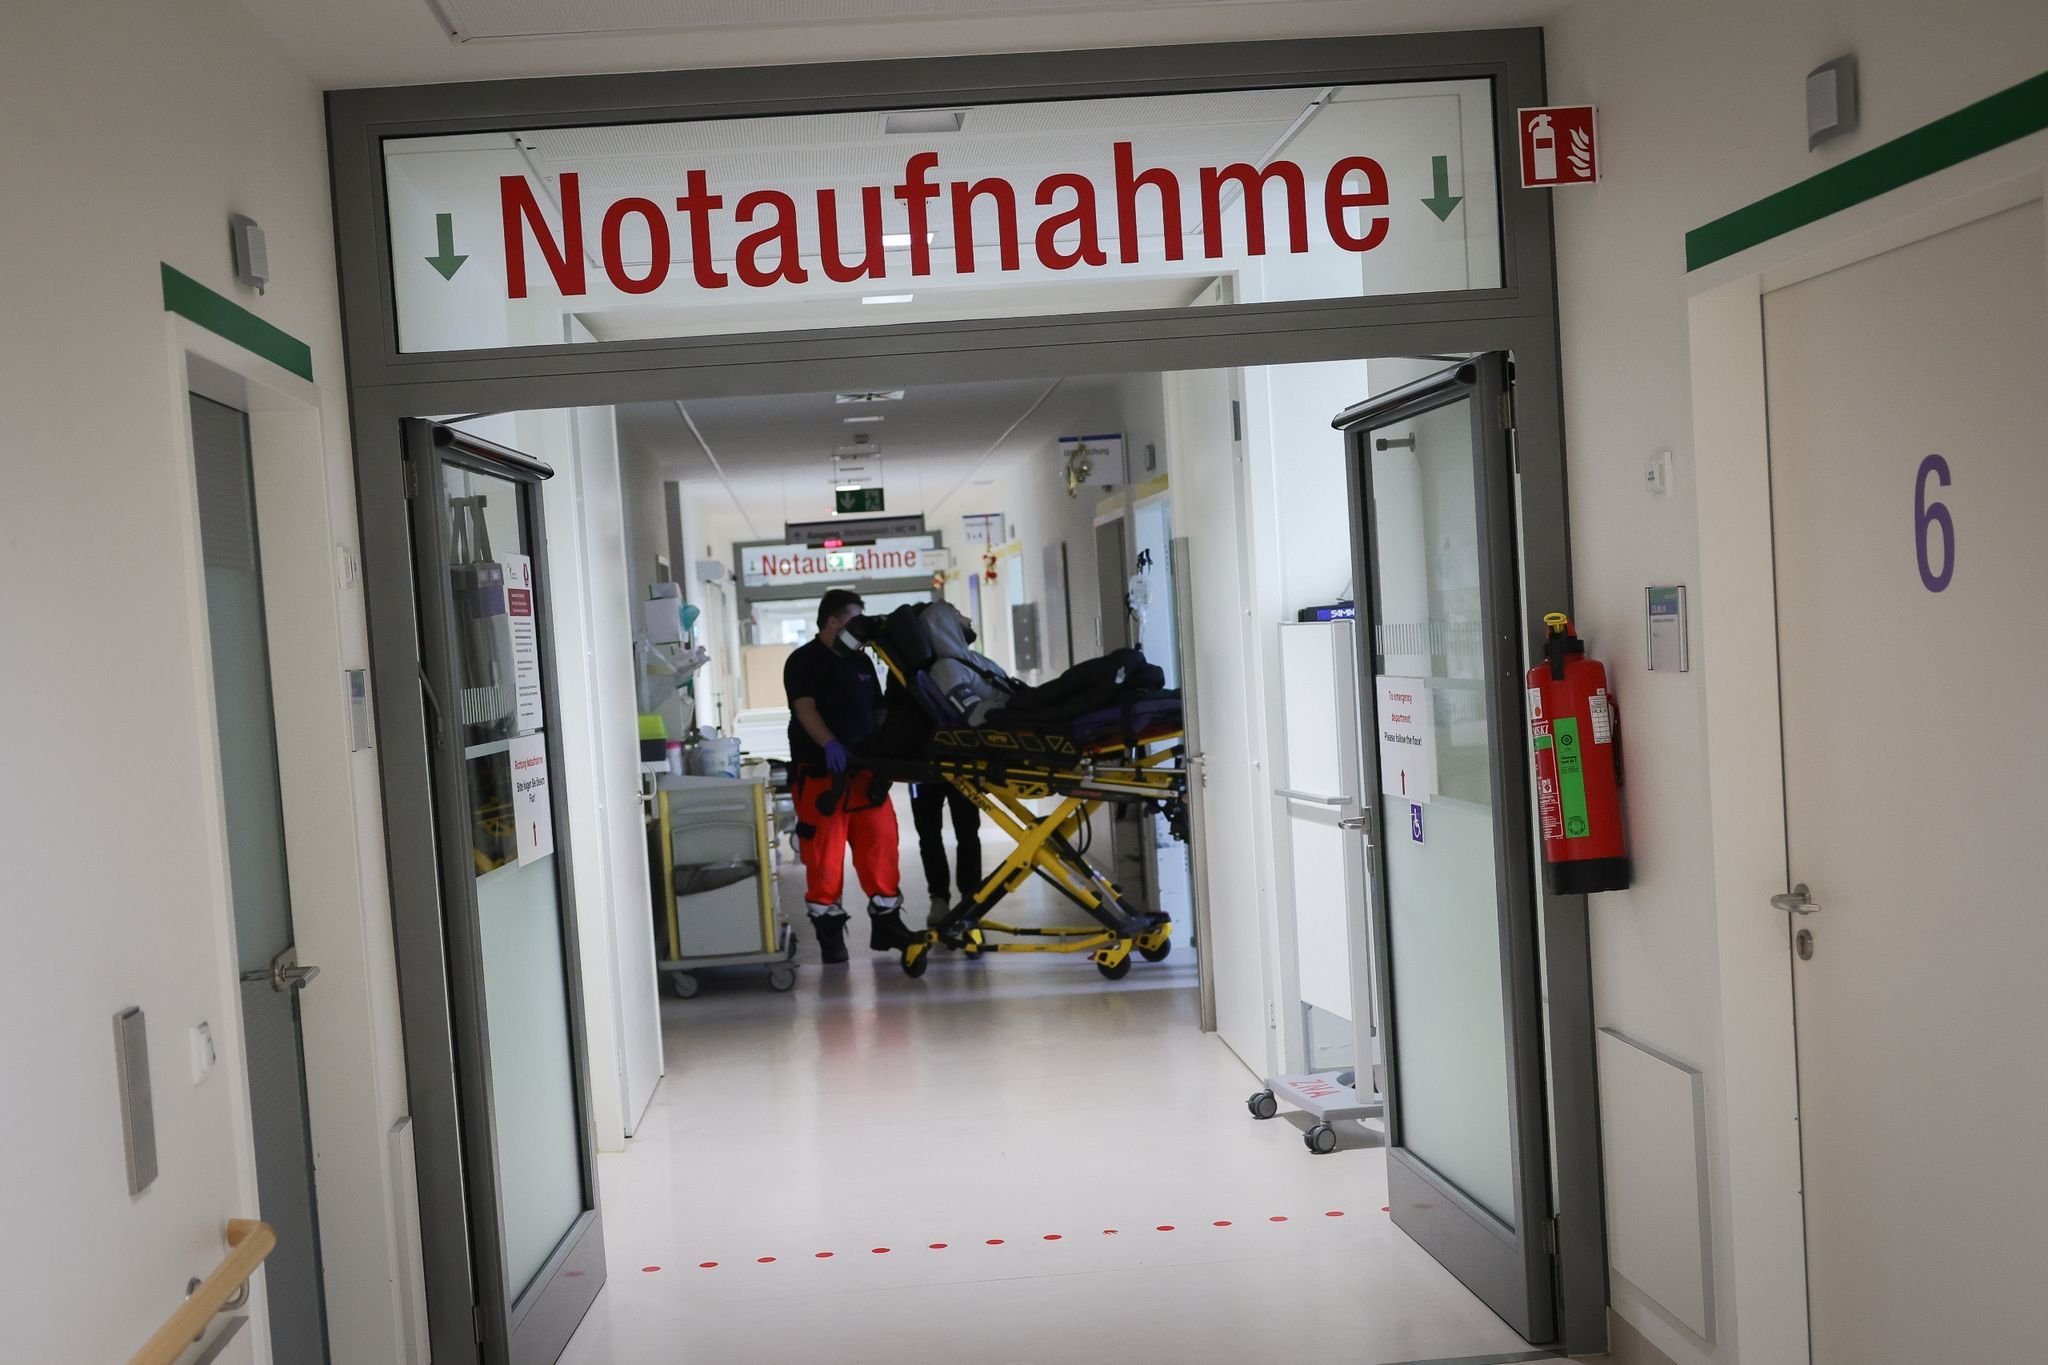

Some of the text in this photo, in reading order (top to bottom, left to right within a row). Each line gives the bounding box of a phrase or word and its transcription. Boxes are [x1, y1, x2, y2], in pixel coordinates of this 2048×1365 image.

[501, 142, 1389, 298] Notaufnahme
[762, 548, 916, 576] Notauahme
[1914, 453, 1955, 593] 6
[1384, 731, 1395, 743] Please
